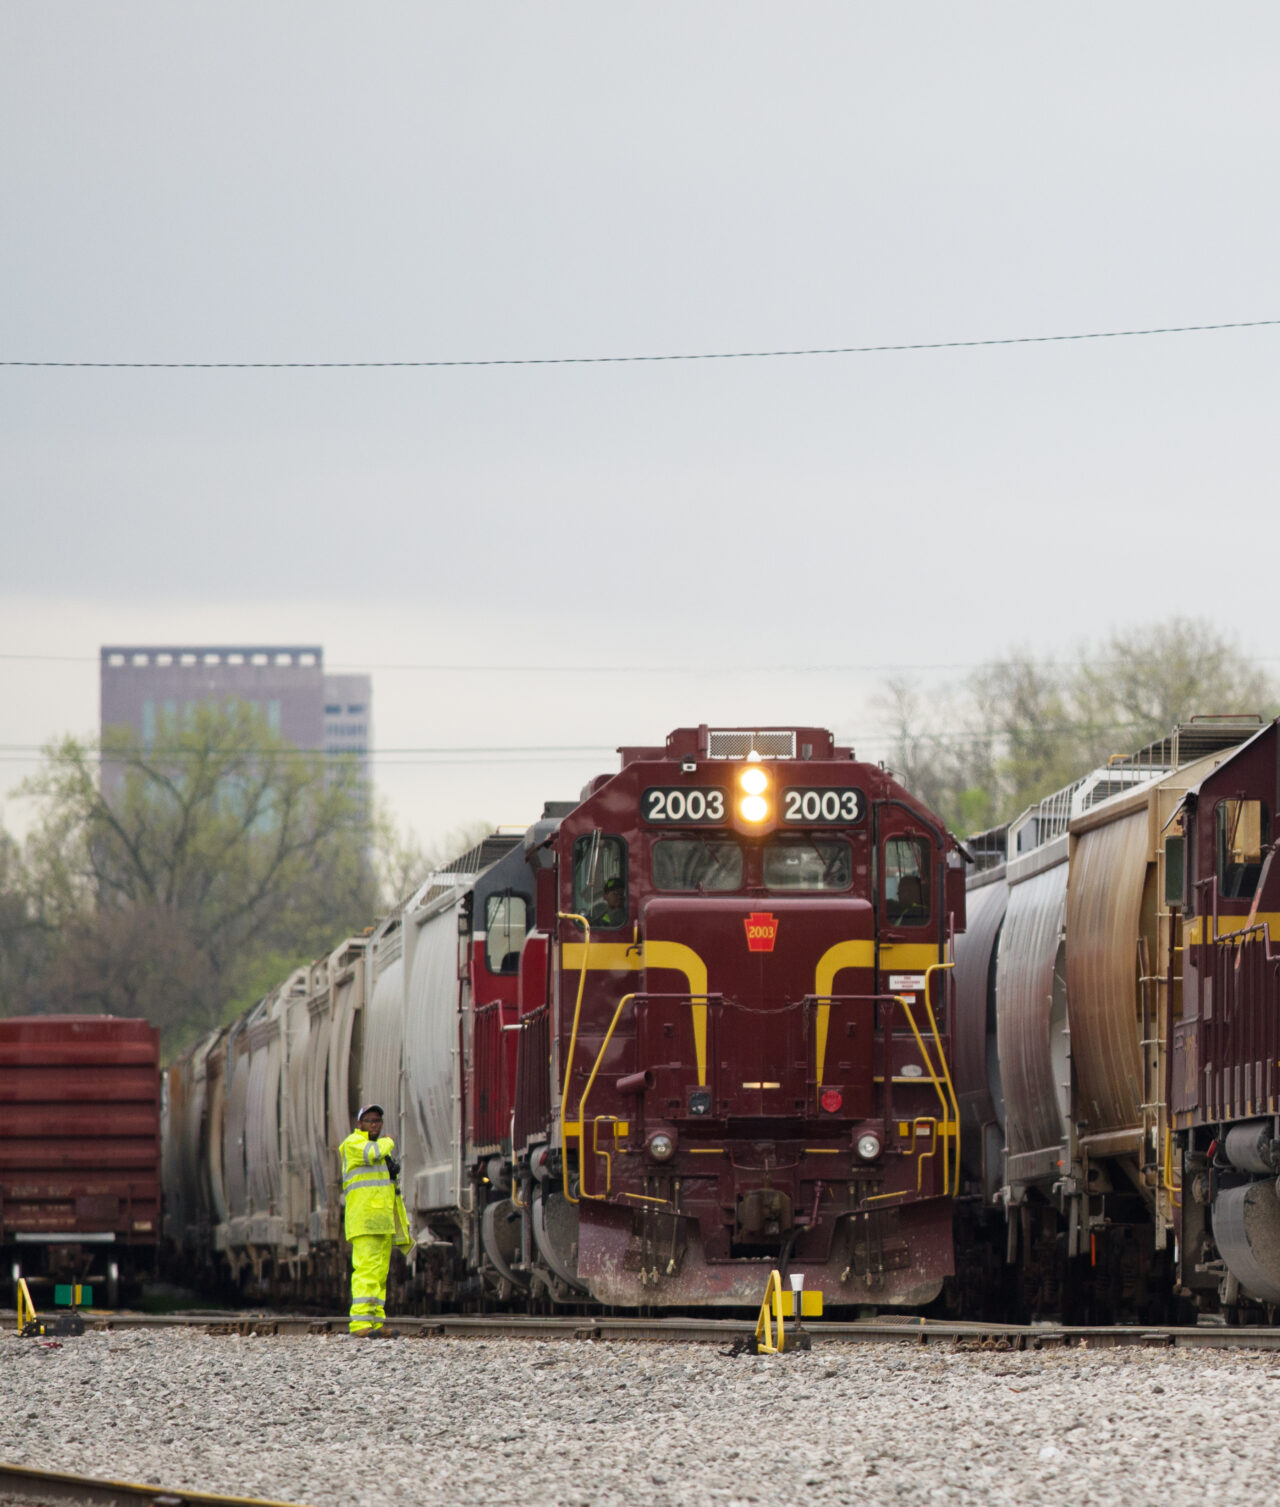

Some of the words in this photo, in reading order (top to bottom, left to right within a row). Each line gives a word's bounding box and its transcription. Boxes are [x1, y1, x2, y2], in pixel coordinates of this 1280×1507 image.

[649, 791, 724, 820] 2003
[785, 791, 859, 821] 2003
[749, 926, 774, 939] 2003
